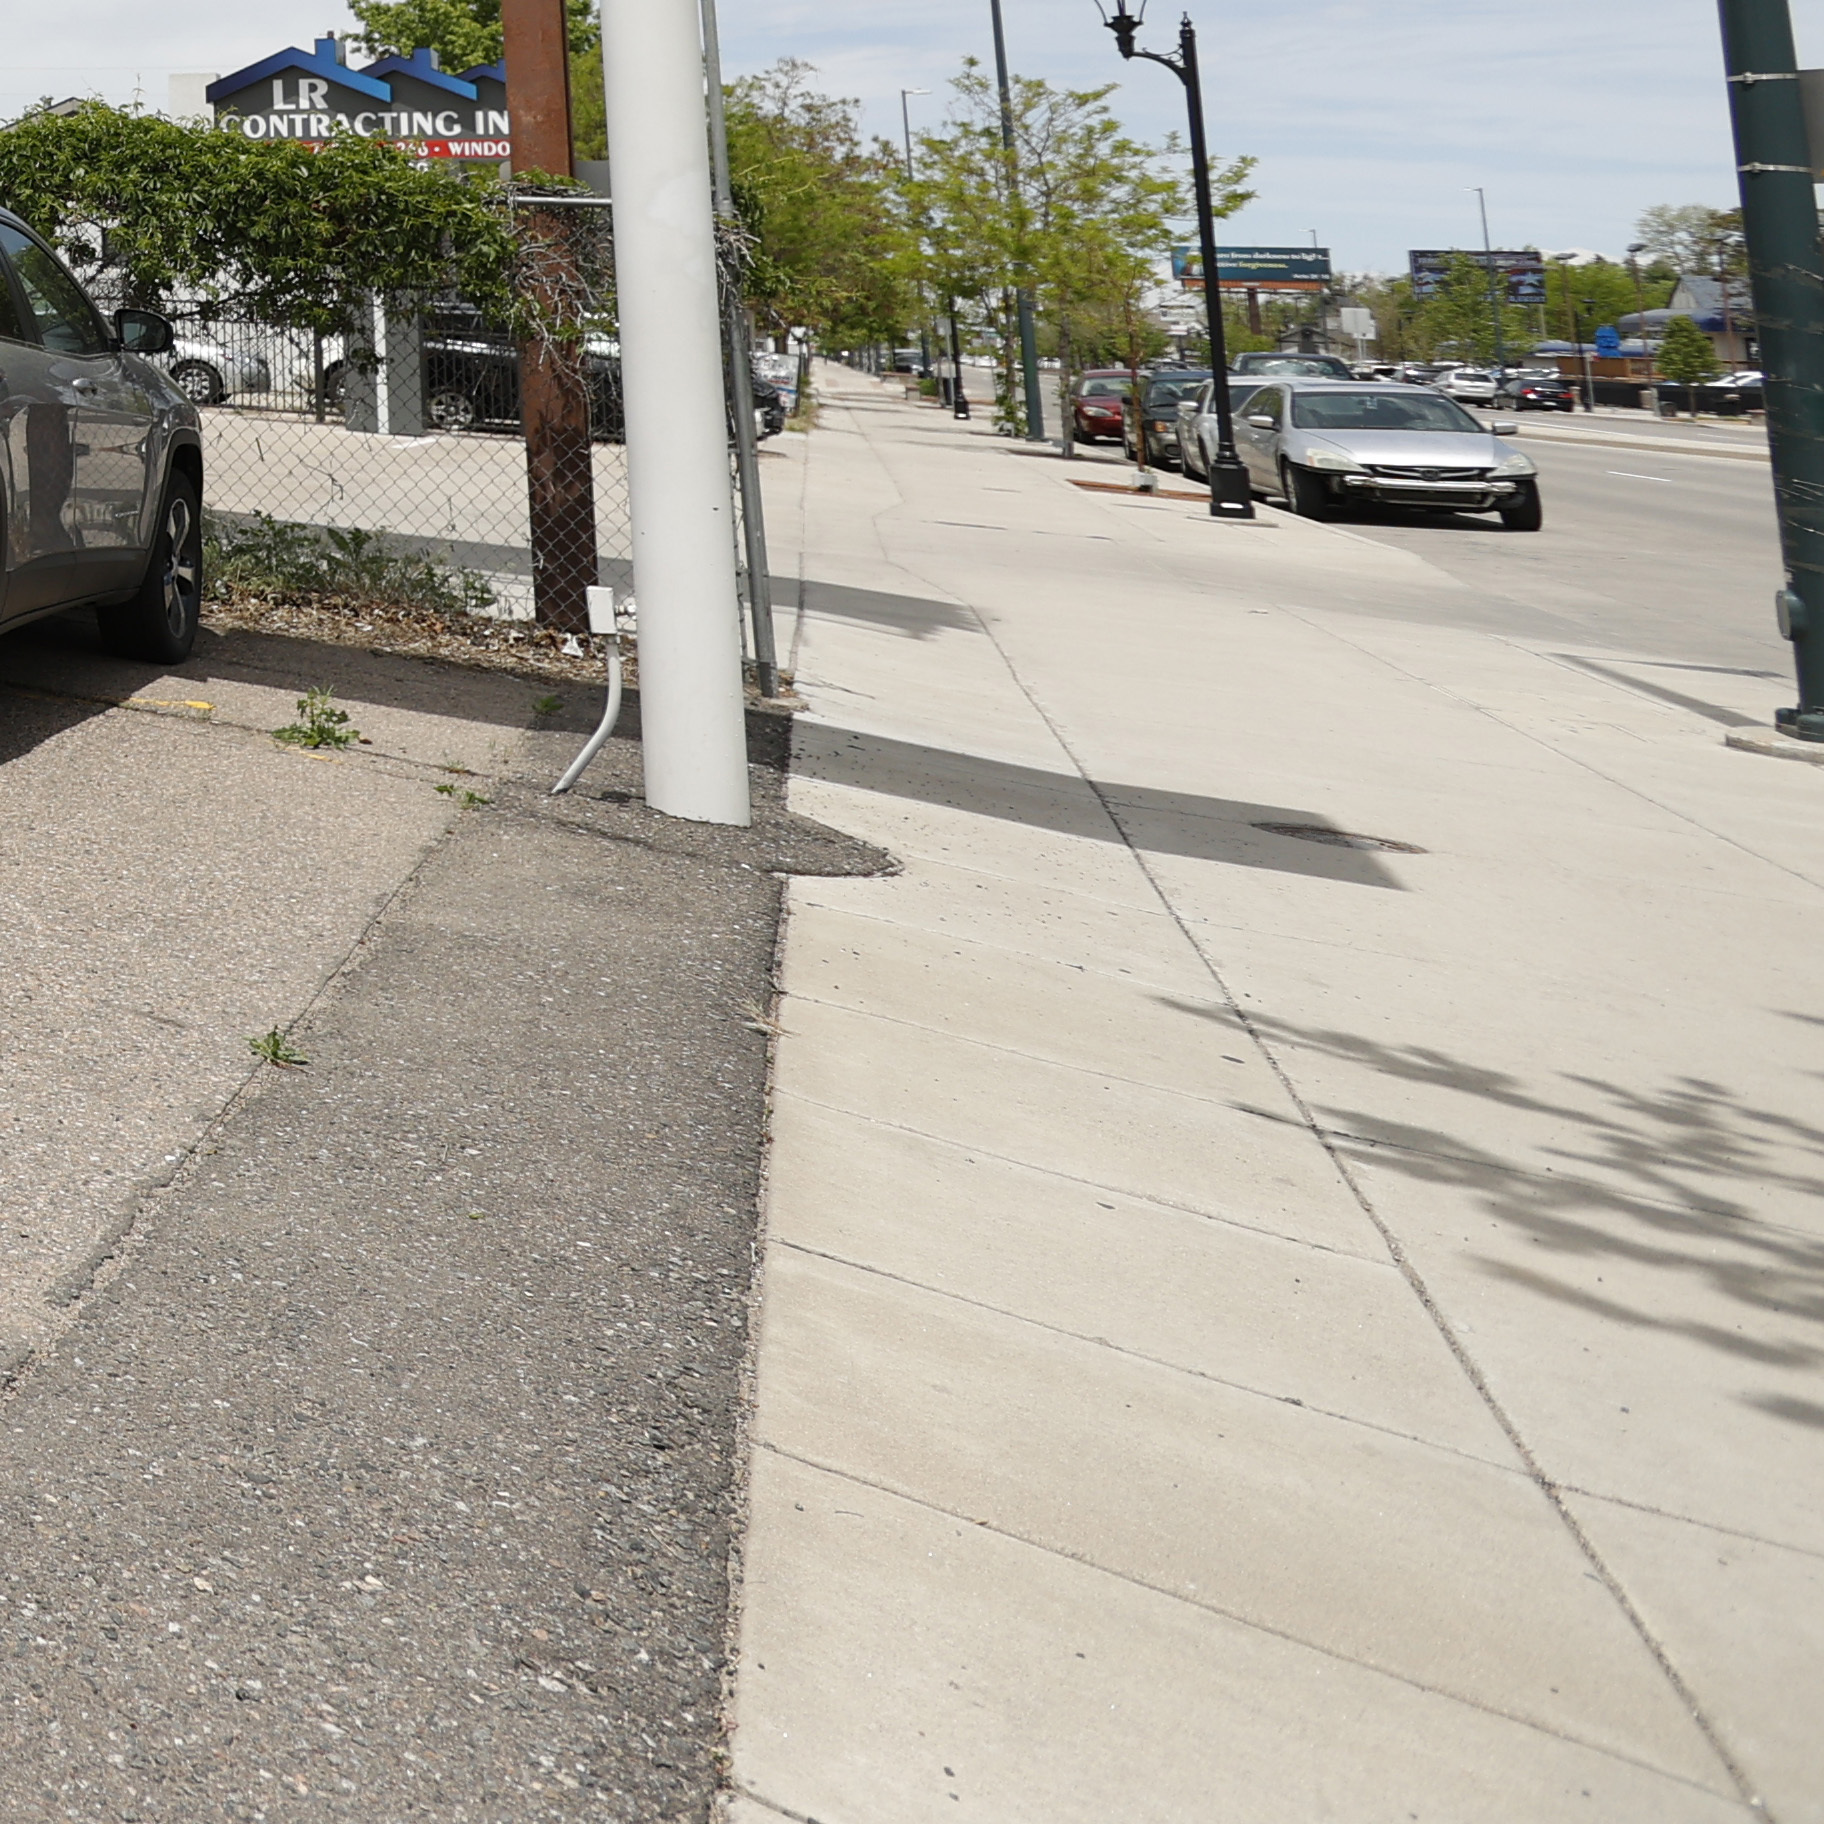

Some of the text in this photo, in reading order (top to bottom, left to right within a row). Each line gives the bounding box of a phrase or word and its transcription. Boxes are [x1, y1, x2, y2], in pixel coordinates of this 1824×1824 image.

[272, 78, 328, 110] LR
[475, 110, 510, 136] IN
[448, 141, 511, 156] WINDO
